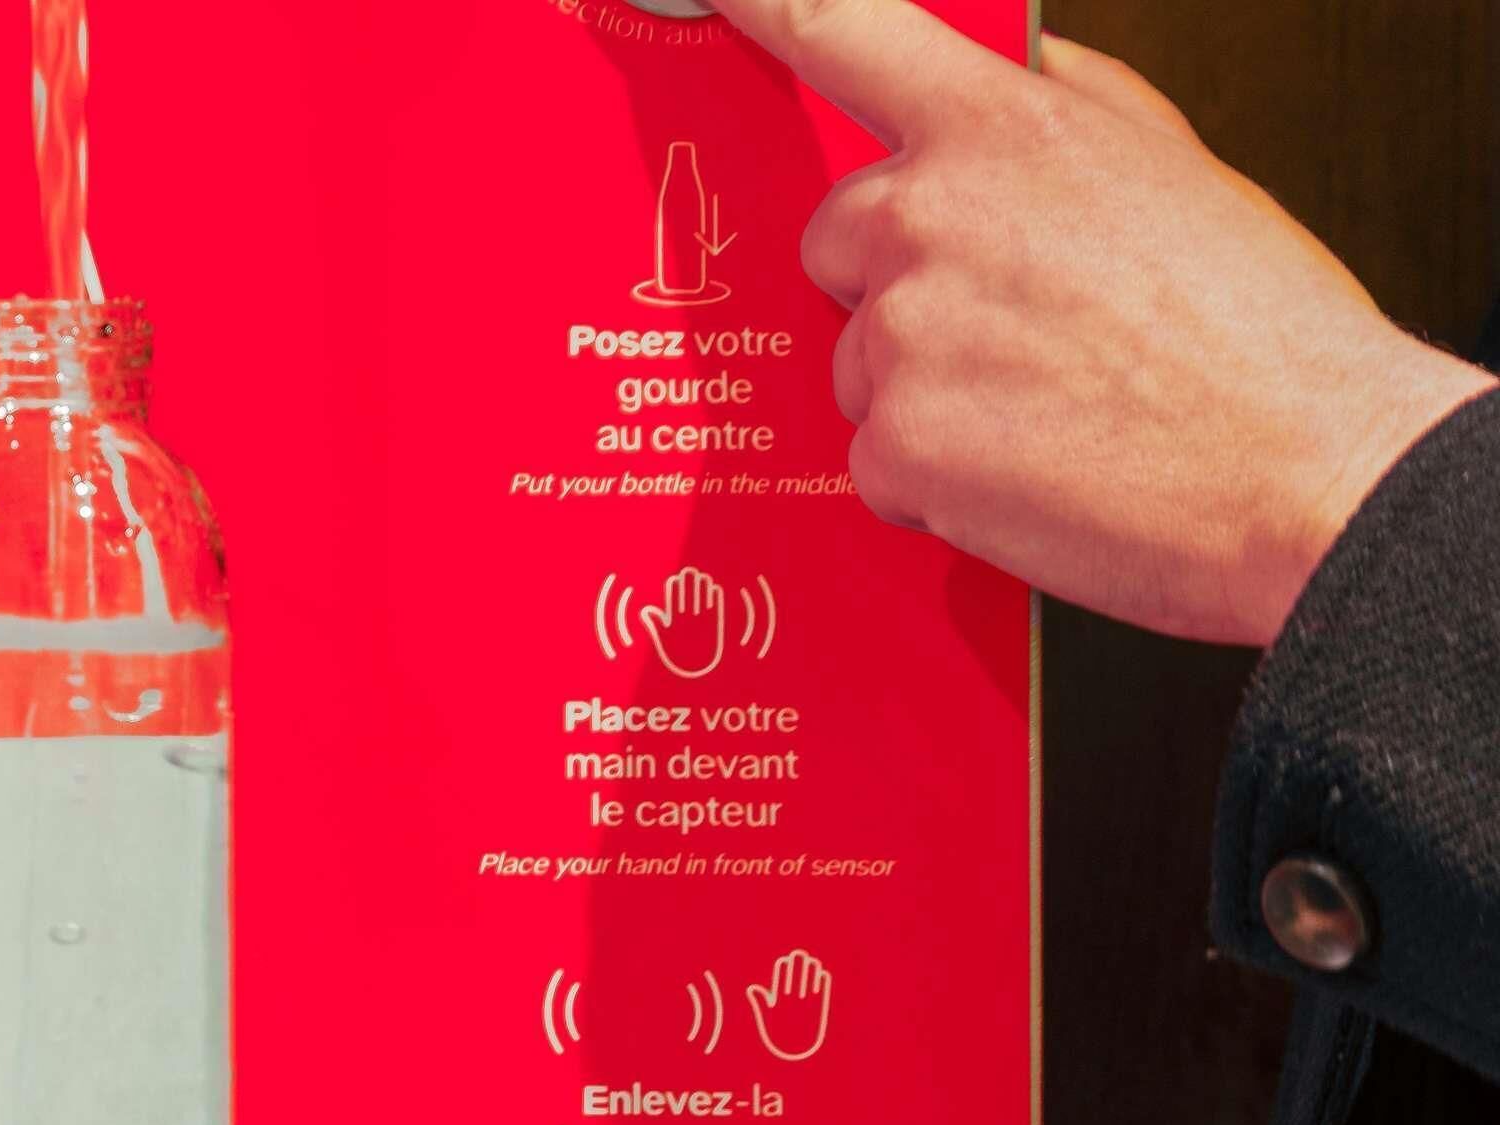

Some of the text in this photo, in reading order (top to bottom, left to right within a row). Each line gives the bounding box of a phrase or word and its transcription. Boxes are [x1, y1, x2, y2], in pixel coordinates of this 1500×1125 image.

[547, 0, 656, 43] ection
[567, 324, 793, 359] Posez votre
[615, 370, 753, 415] gourde
[595, 421, 774, 454] au centre
[509, 472, 555, 496] Put
[557, 476, 618, 500] your
[618, 471, 696, 497] bottle
[700, 471, 724, 494] in
[729, 472, 771, 495] the
[563, 696, 799, 734] Placez votre
[564, 745, 799, 780] main devant
[590, 791, 783, 836] le capteur
[478, 851, 896, 881] Place your hand in front of sensor
[581, 1081, 784, 1117] Enlevez-la
